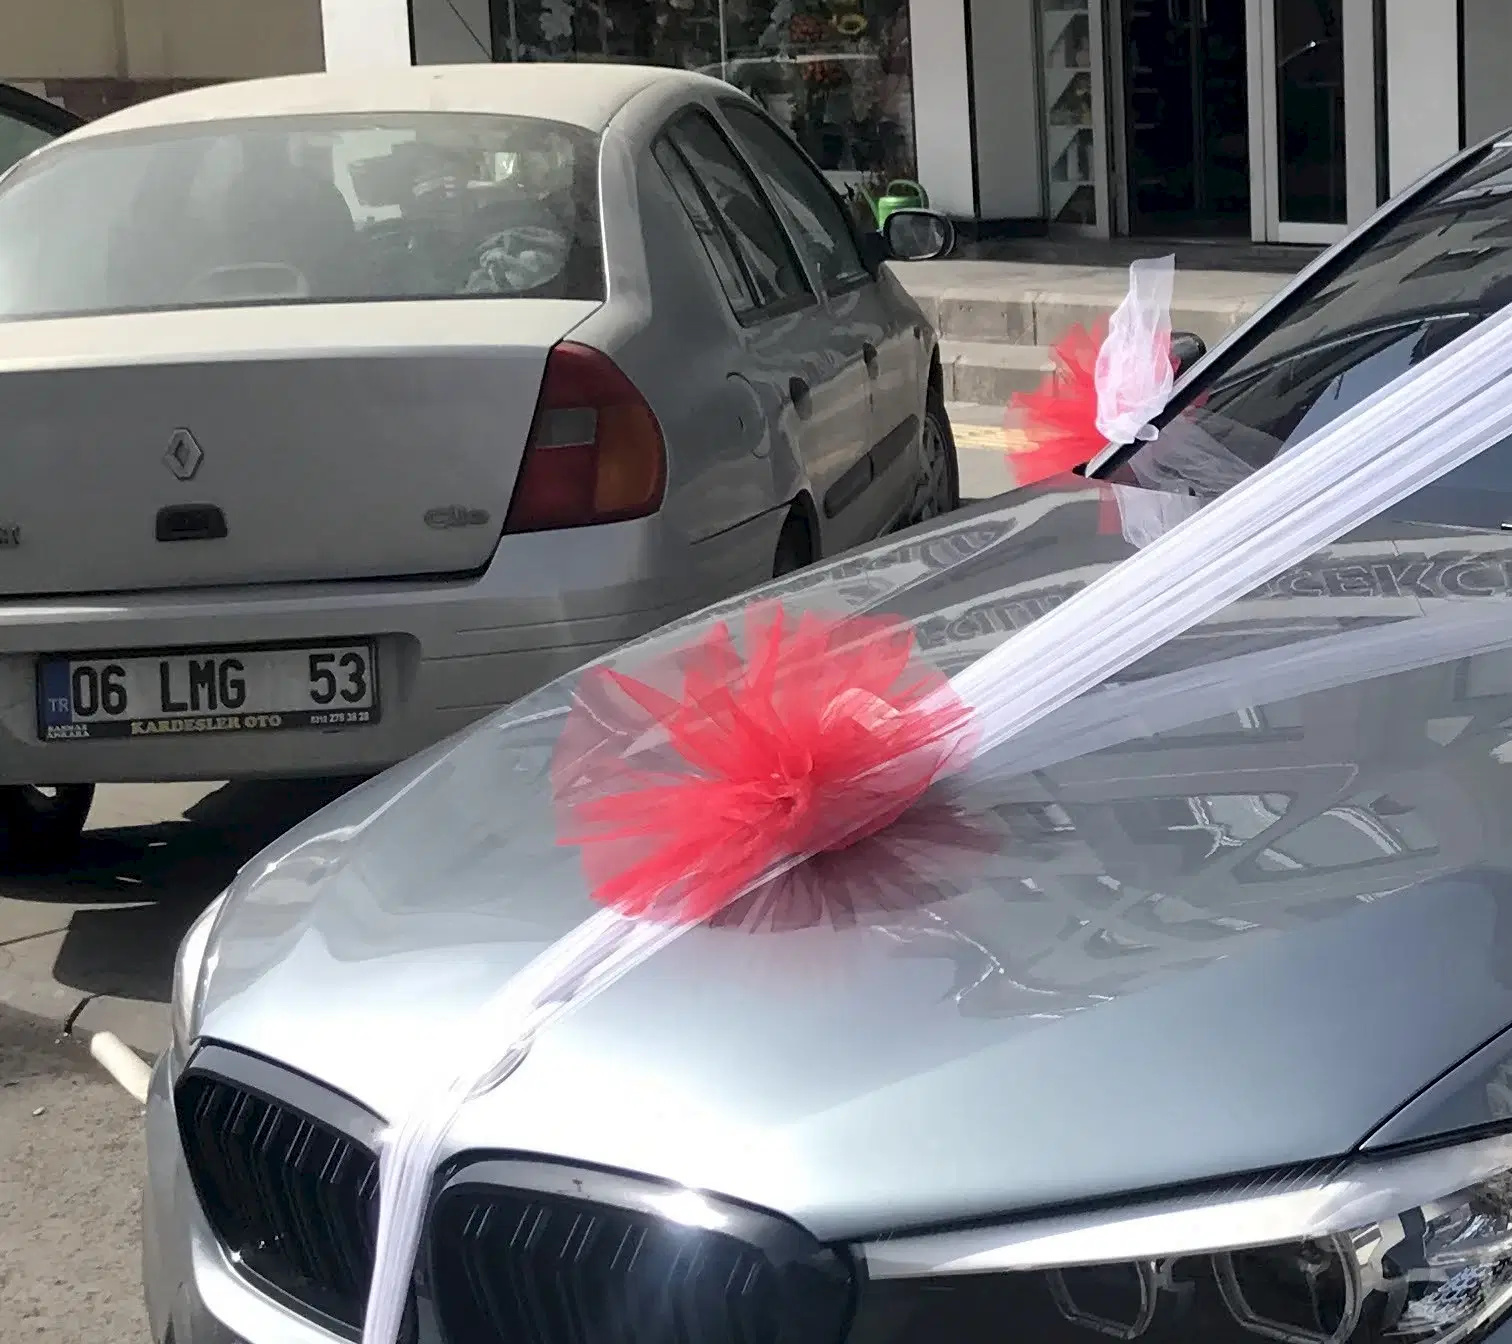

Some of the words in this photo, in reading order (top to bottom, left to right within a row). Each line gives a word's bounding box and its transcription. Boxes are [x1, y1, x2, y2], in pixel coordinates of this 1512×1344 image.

[72, 664, 127, 718] 06
[160, 658, 247, 713] LMG
[308, 652, 367, 705] 53
[48, 697, 69, 714] TR
[244, 715, 283, 729] OTO
